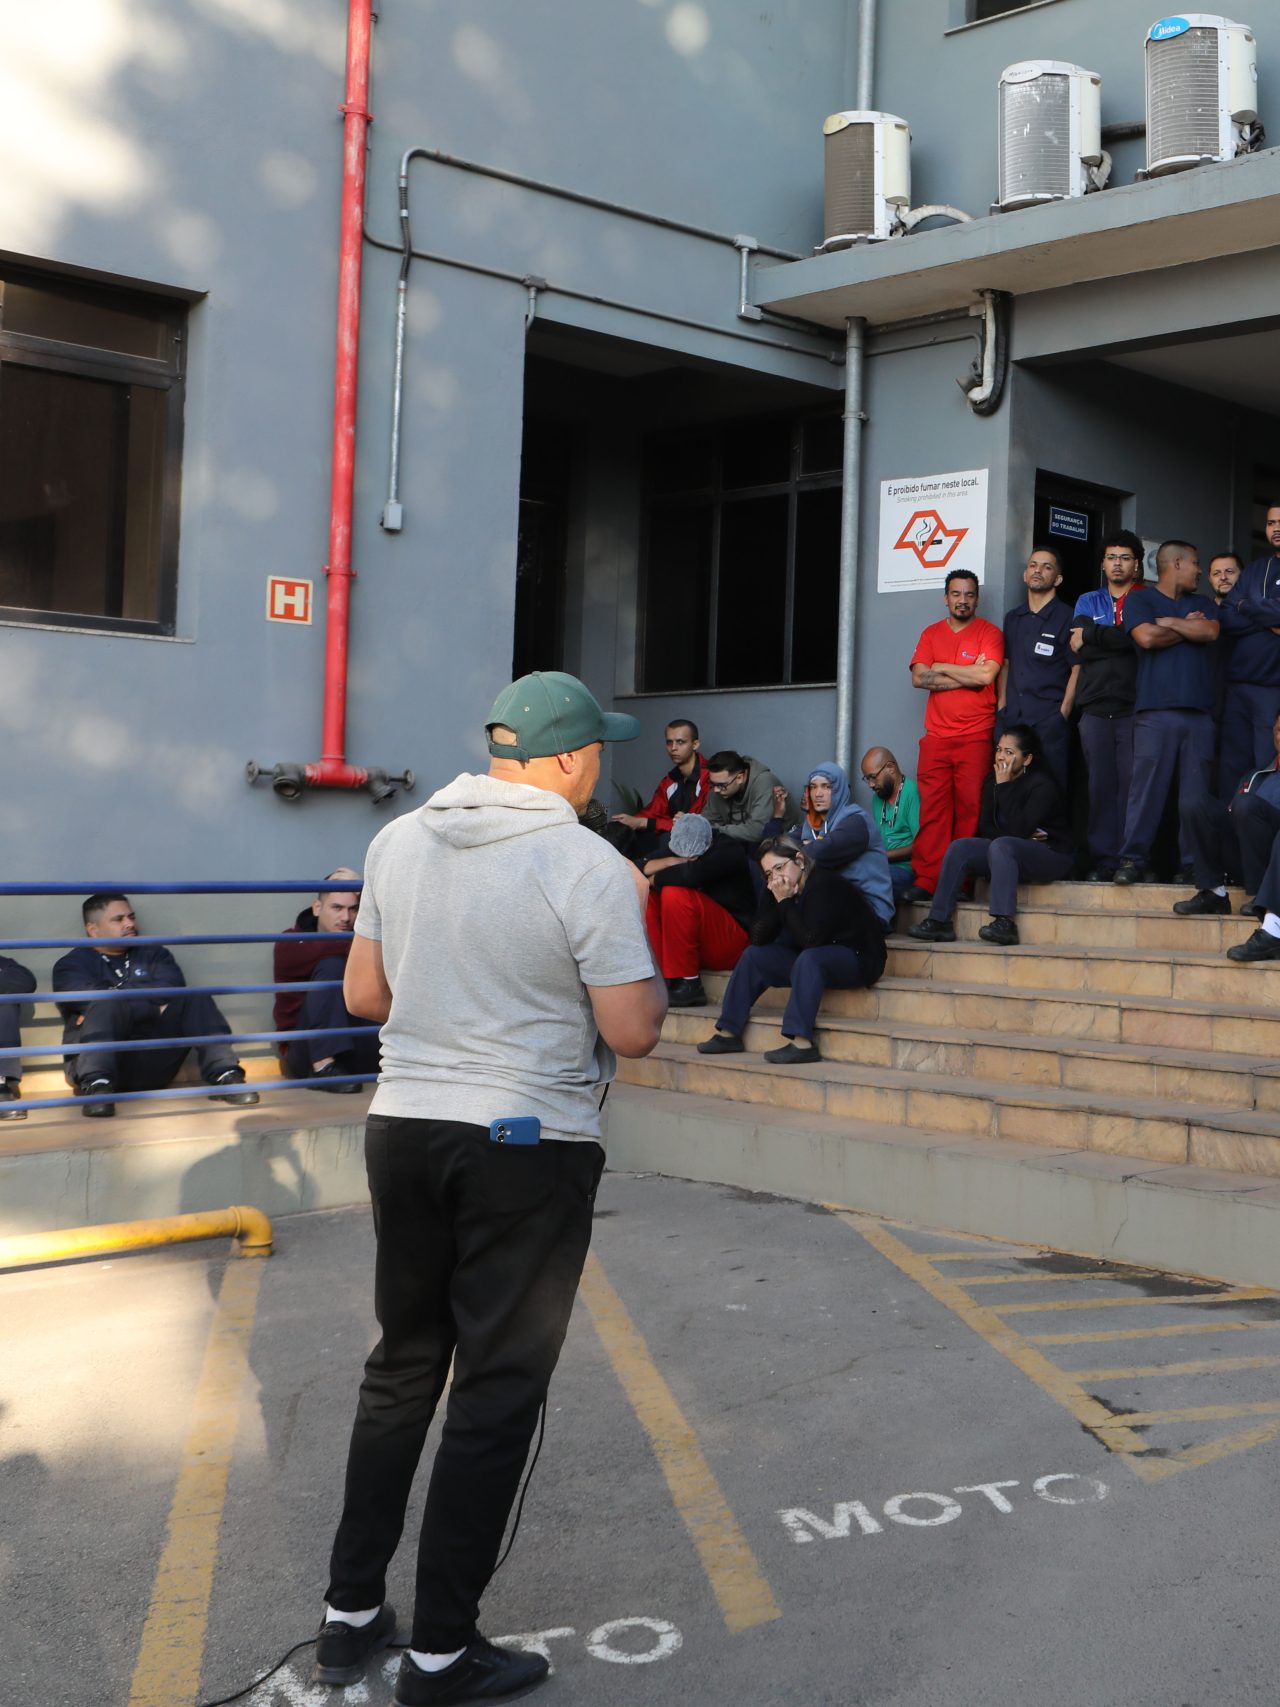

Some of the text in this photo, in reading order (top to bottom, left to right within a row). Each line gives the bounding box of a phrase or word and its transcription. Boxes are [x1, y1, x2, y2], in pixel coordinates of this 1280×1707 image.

[1157, 25, 1181, 35] Midea
[888, 477, 979, 496] É proibido fumar neste local.
[897, 495, 917, 503] Smoking
[917, 493, 942, 502] prohibited
[1054, 514, 1084, 525] SEGURANÇA
[1060, 524, 1085, 534] TRABALHO
[274, 584, 305, 617] H
[774, 1473, 1111, 1543] MOTO
